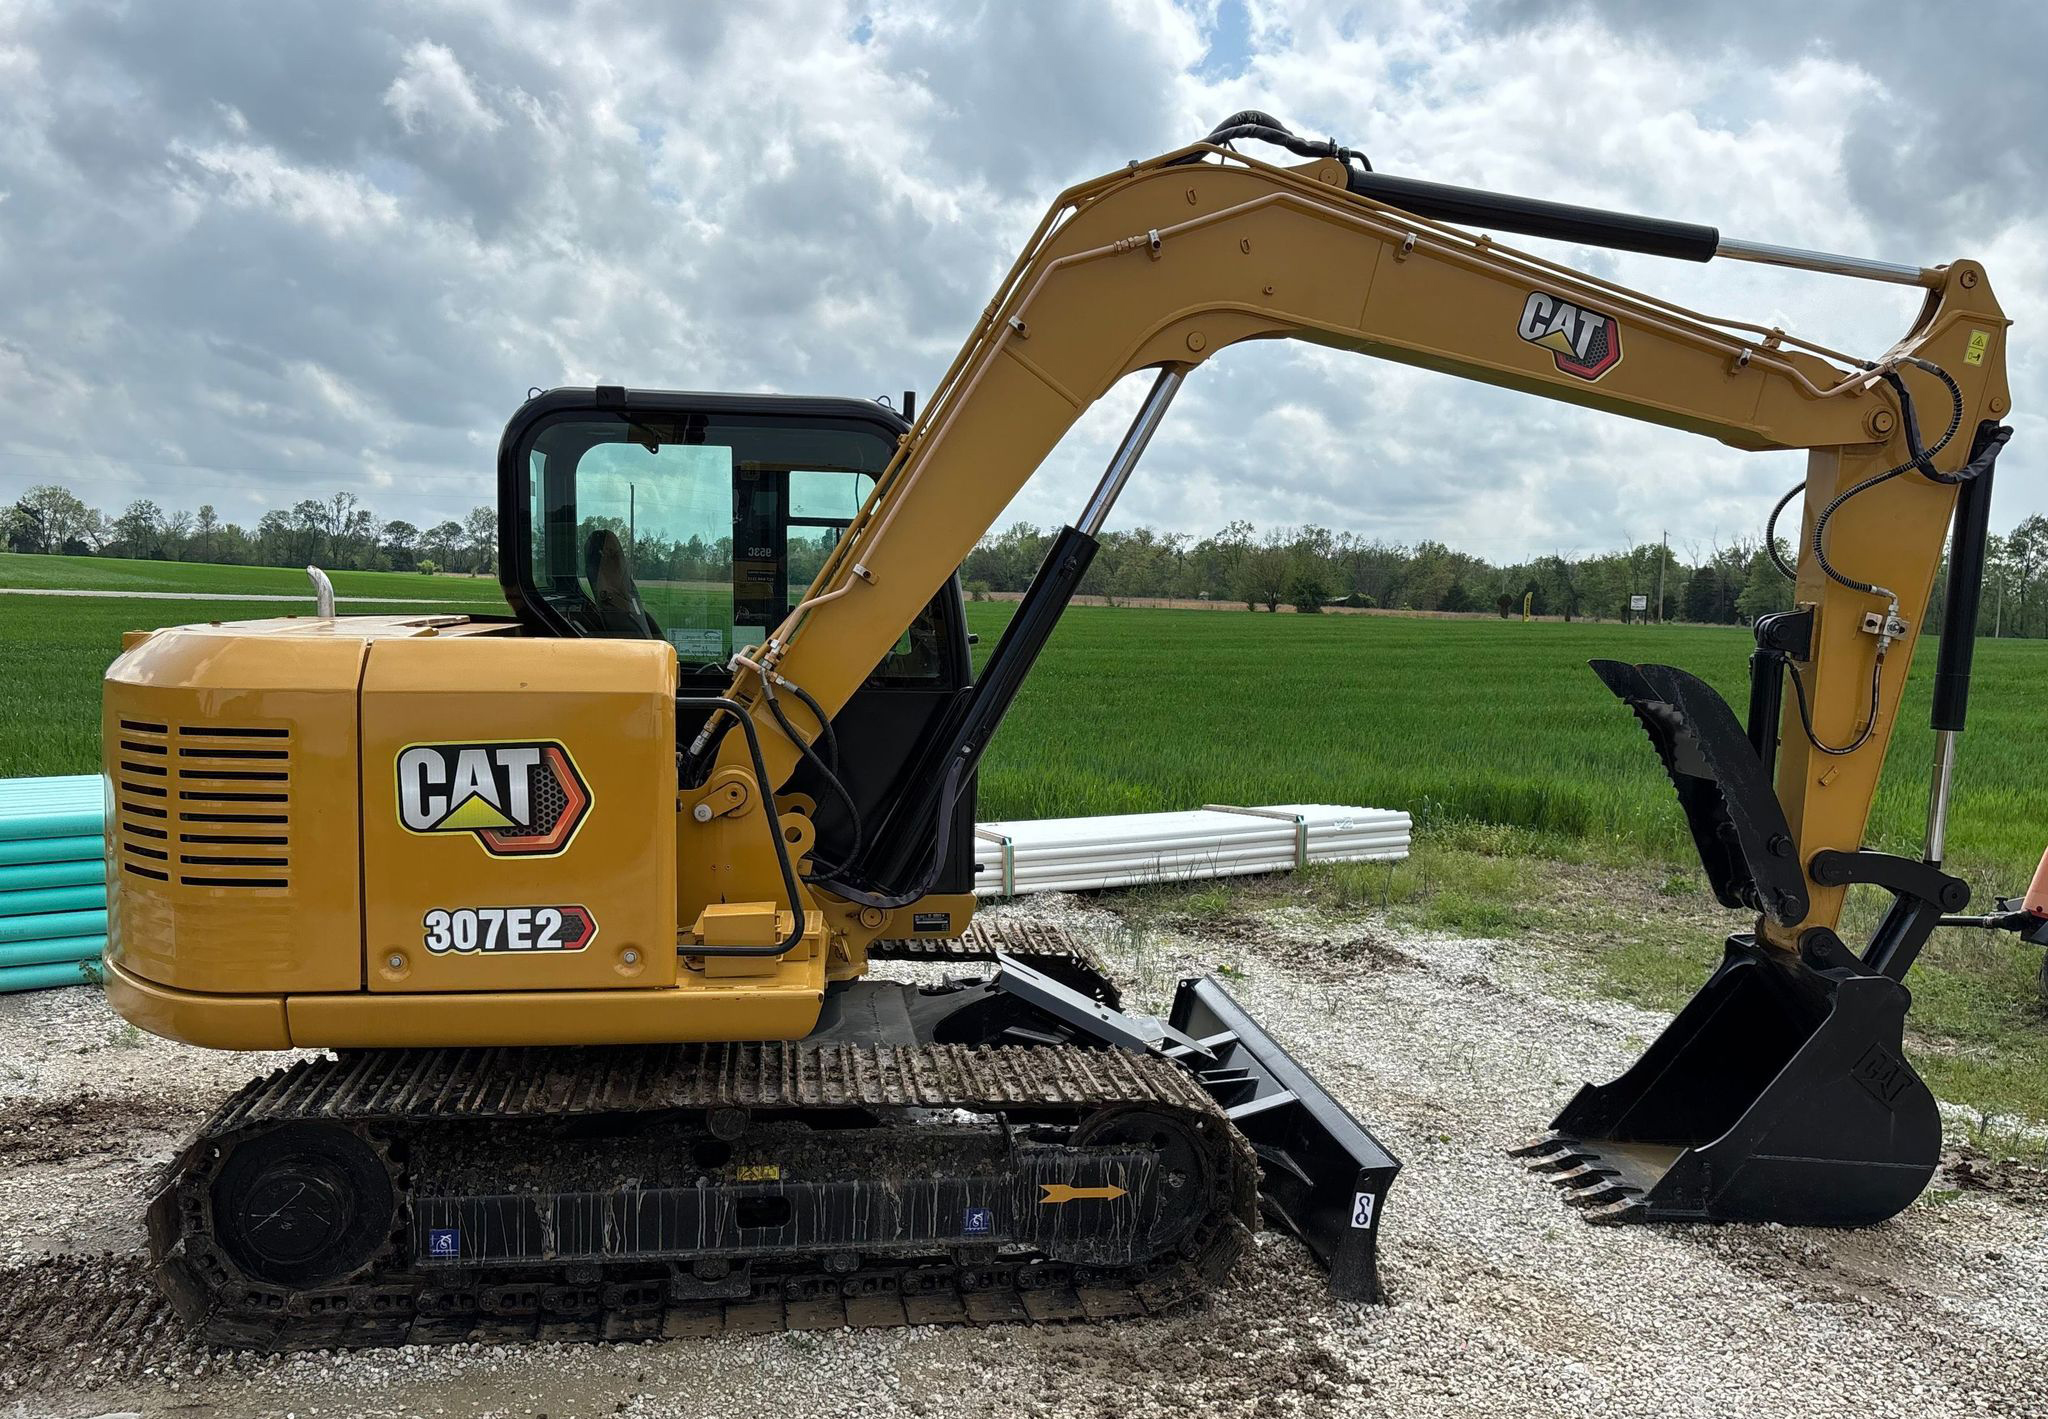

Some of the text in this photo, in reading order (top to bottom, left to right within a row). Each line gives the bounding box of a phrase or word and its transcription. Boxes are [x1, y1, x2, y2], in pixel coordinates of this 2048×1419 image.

[1520, 292, 1605, 359] CAT
[401, 748, 540, 829] CAT
[426, 908, 562, 949] 307E2
[1863, 1053, 1914, 1101] CAT
